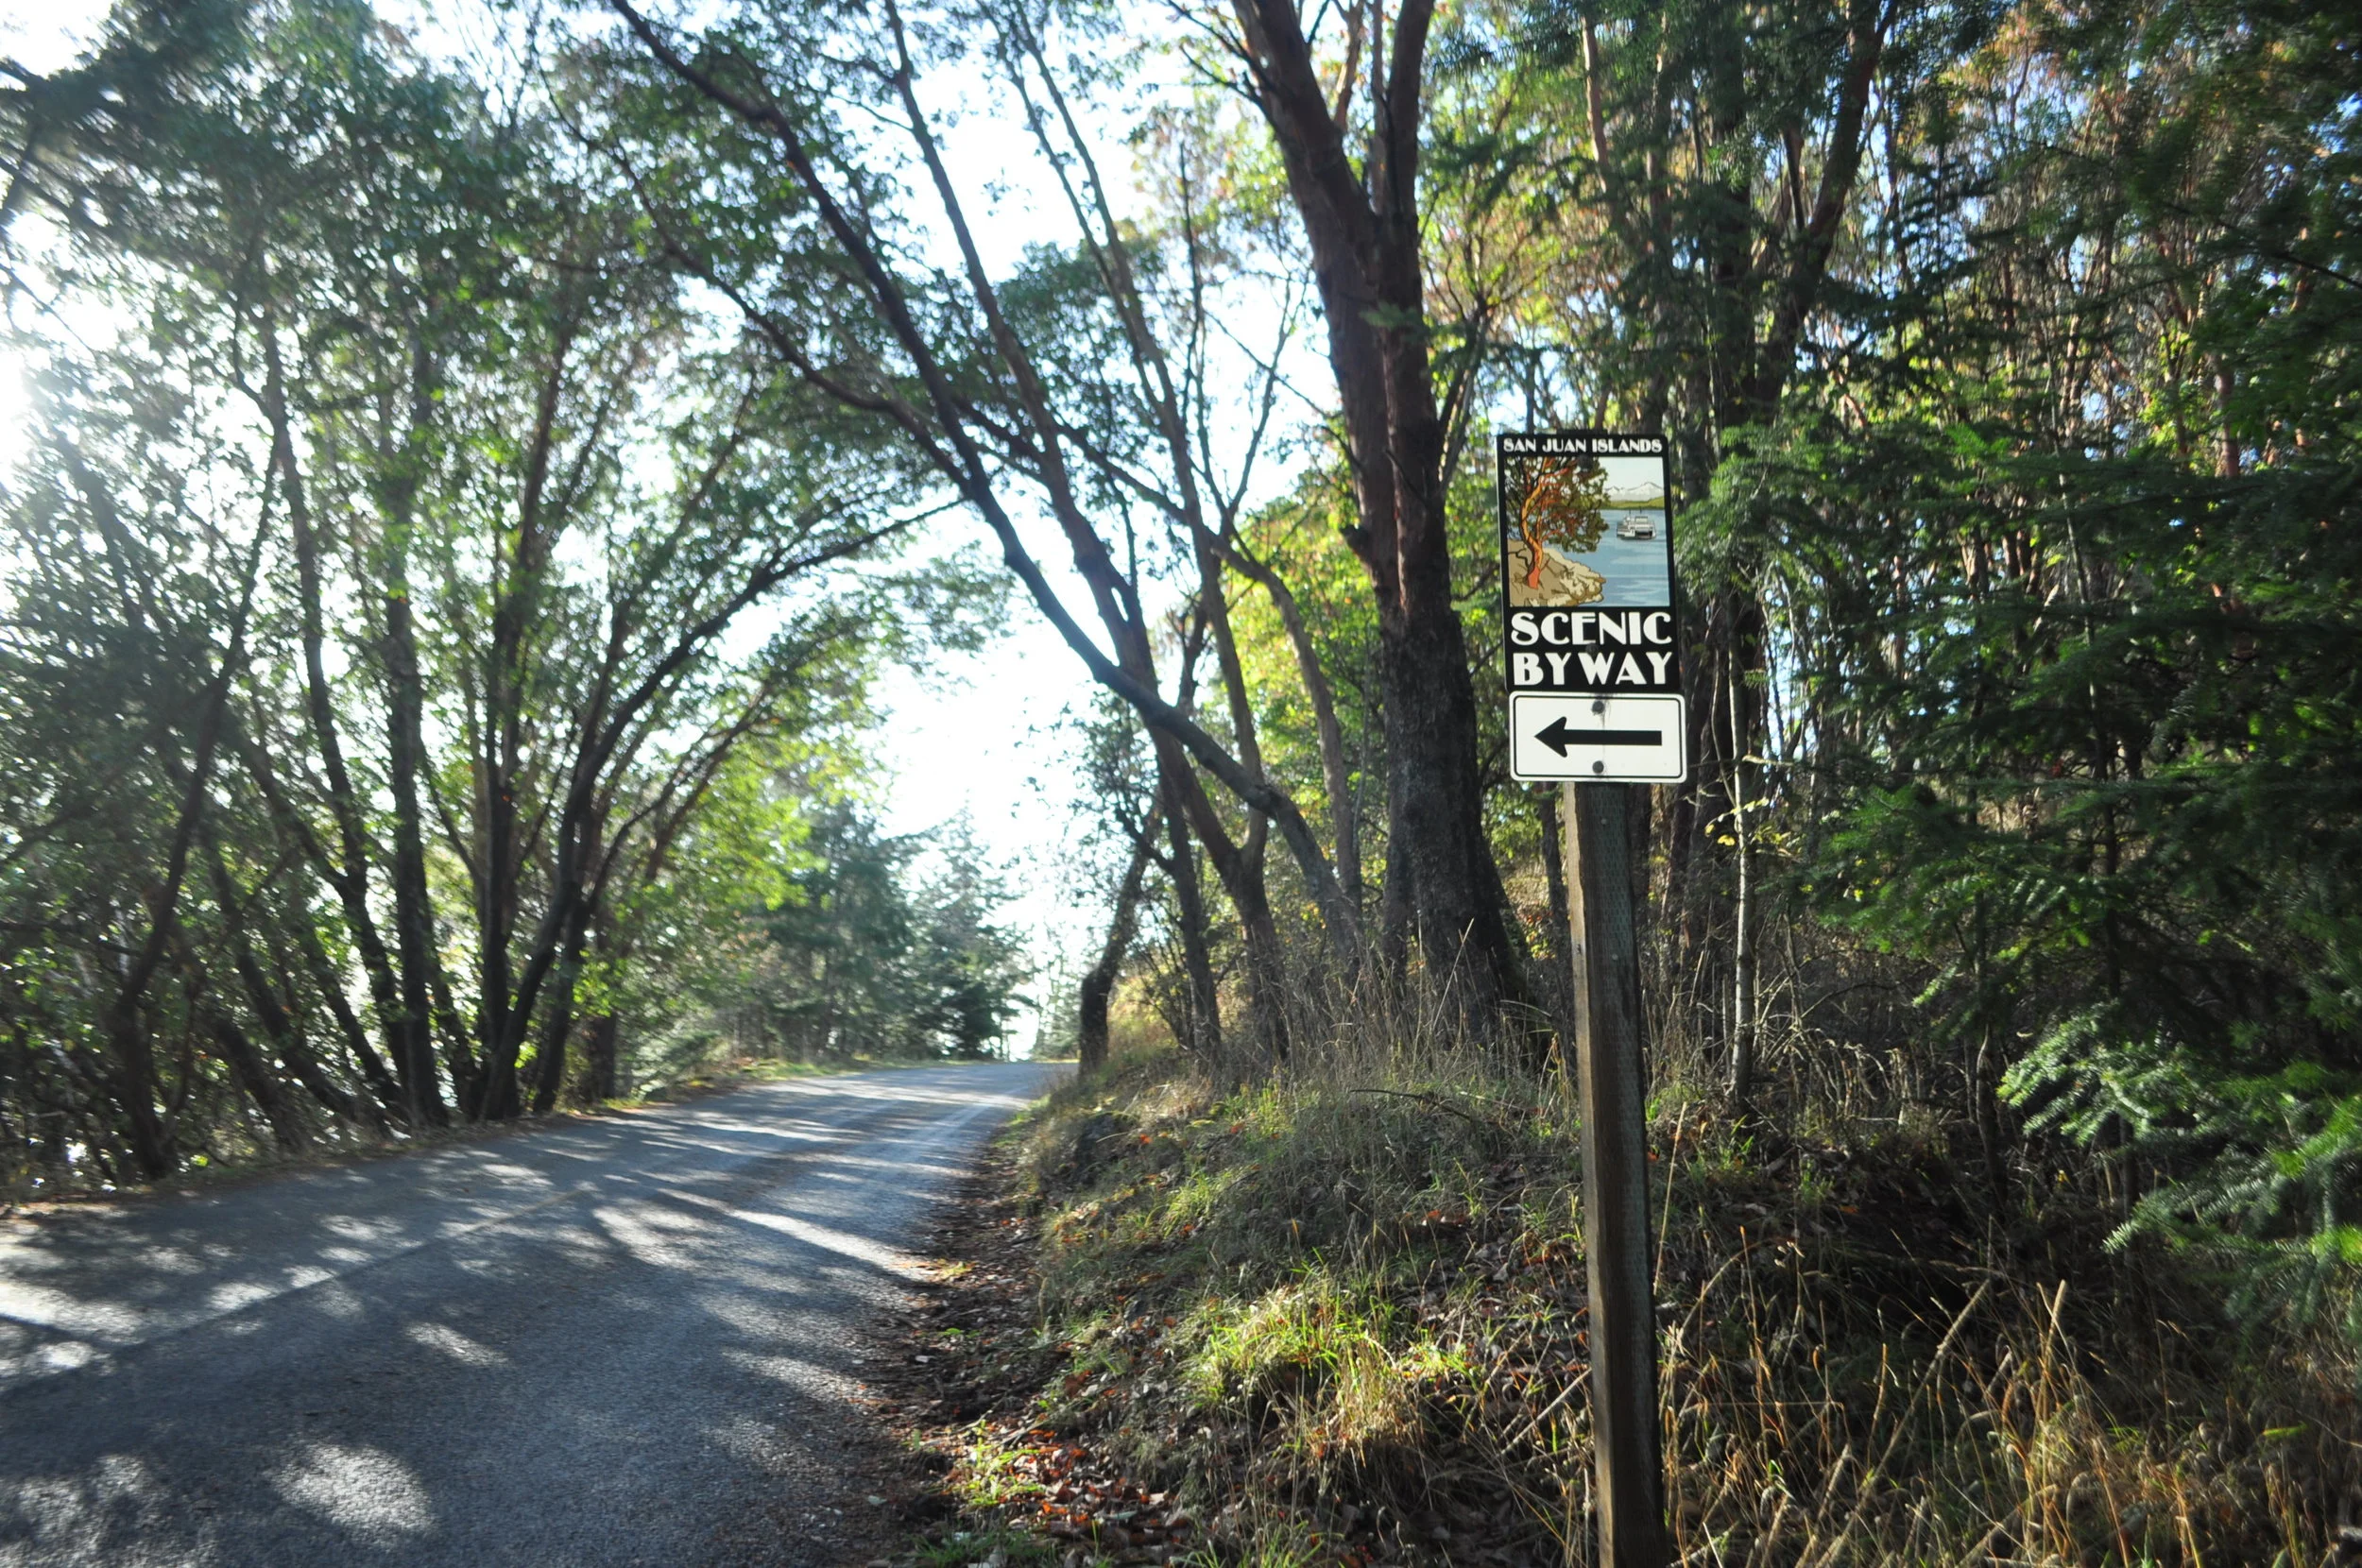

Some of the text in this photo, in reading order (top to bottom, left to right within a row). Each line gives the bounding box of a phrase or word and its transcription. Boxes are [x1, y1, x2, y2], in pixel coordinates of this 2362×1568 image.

[1502, 437, 1663, 453] SAN JUAN ISLANDS
[1510, 611, 1672, 646] SCENIC
[1512, 651, 1673, 686] BYWAY
